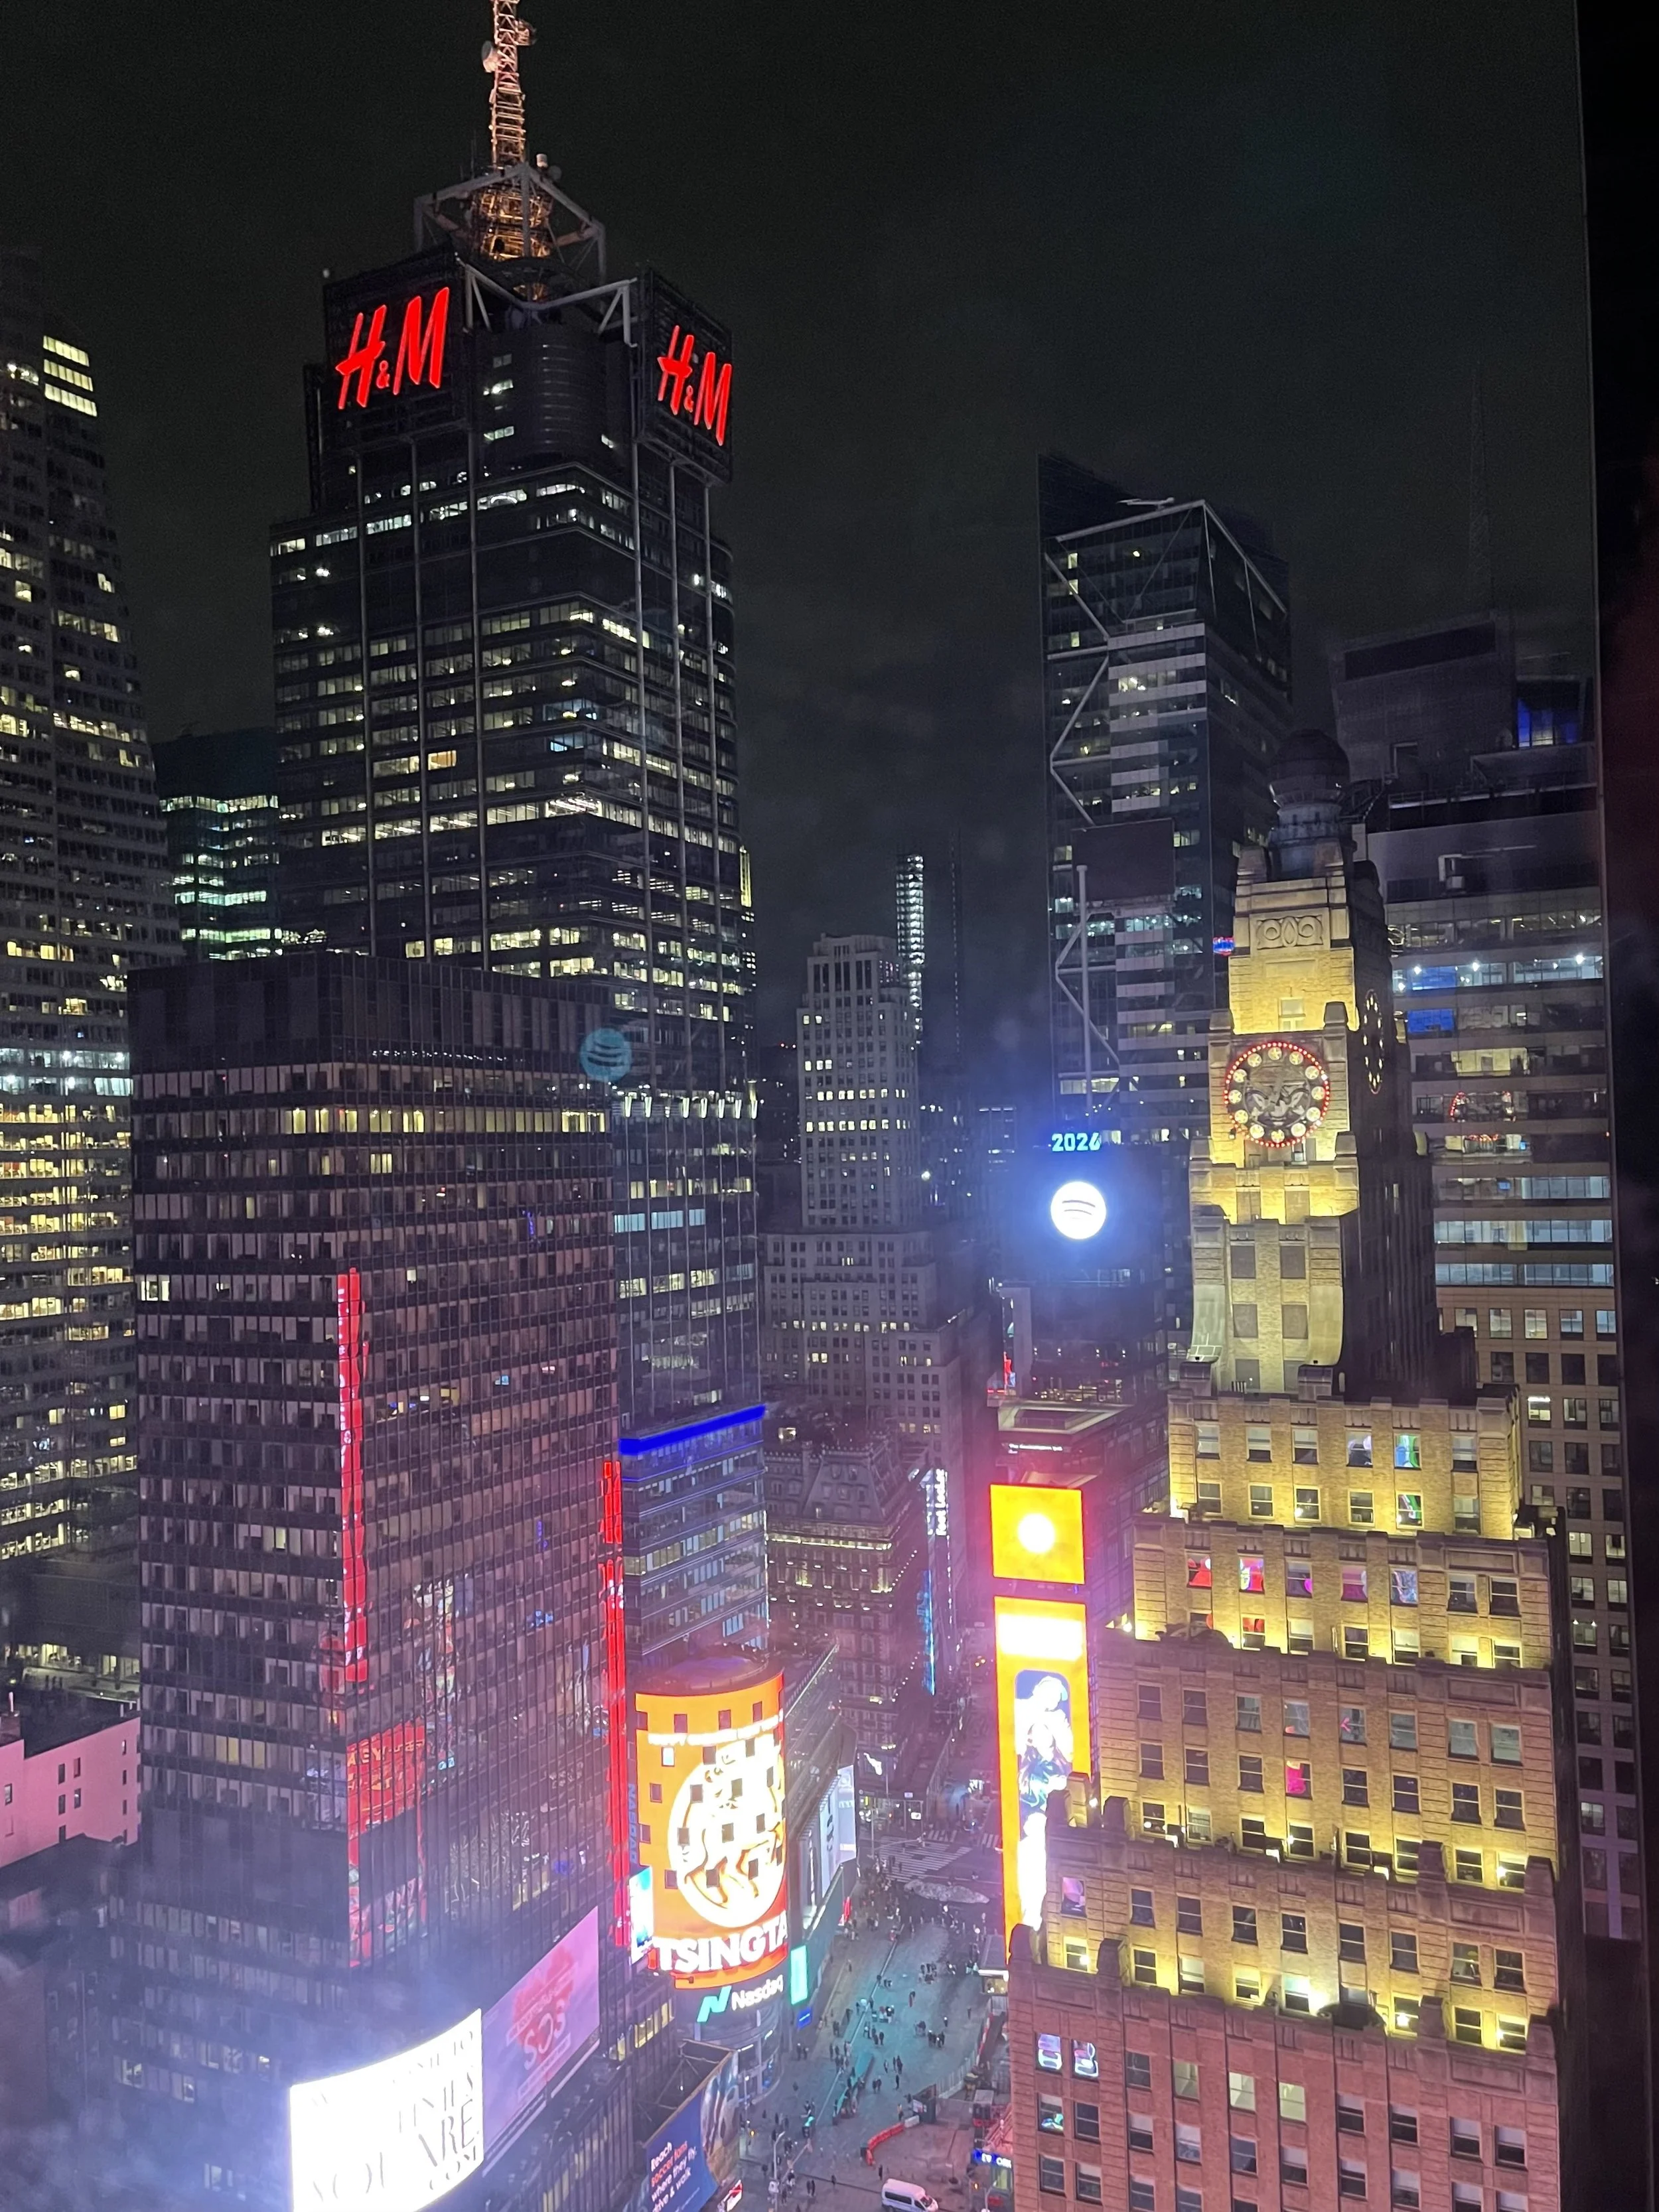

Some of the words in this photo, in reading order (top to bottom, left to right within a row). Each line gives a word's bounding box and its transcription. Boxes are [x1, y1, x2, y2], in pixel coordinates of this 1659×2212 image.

[334, 287, 449, 409] H&M
[658, 325, 732, 447] H&M
[1051, 1132, 1102, 1152] 2026
[731, 1974, 784, 2011] Nasdaq
